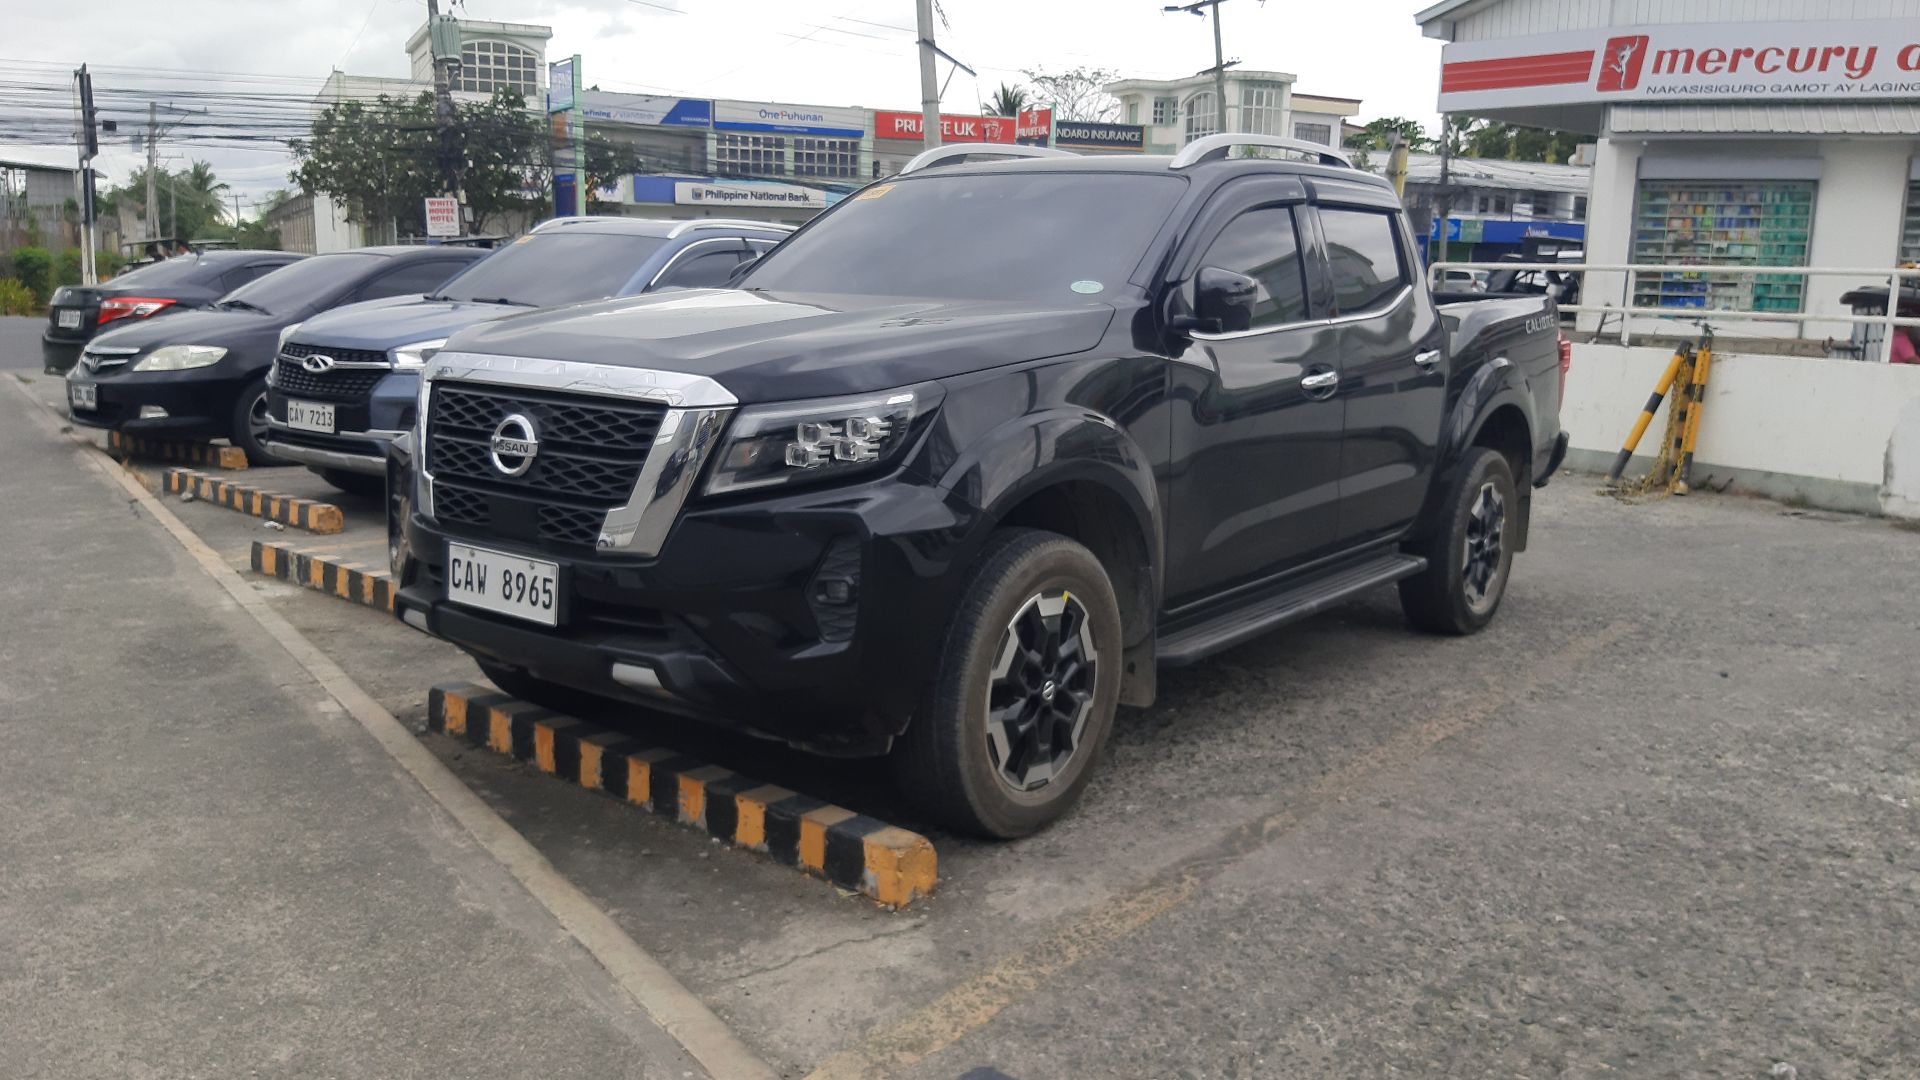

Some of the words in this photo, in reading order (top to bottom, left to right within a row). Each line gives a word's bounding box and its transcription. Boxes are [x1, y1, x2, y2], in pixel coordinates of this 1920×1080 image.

[1651, 45, 1878, 80] mercury
[1646, 83, 1767, 95] NAKASISIGURO
[1770, 83, 1830, 94] GAMOT
[1834, 82, 1856, 93] AY
[1056, 127, 1090, 139] NDARD
[1090, 129, 1141, 142] INSURANCE
[705, 189, 749, 202] Philippine
[750, 191, 787, 201] National
[788, 193, 810, 202] Bank
[289, 407, 304, 423] CAY
[309, 409, 333, 427] 7213
[452, 557, 487, 595] CAW
[502, 568, 553, 610] 8965
